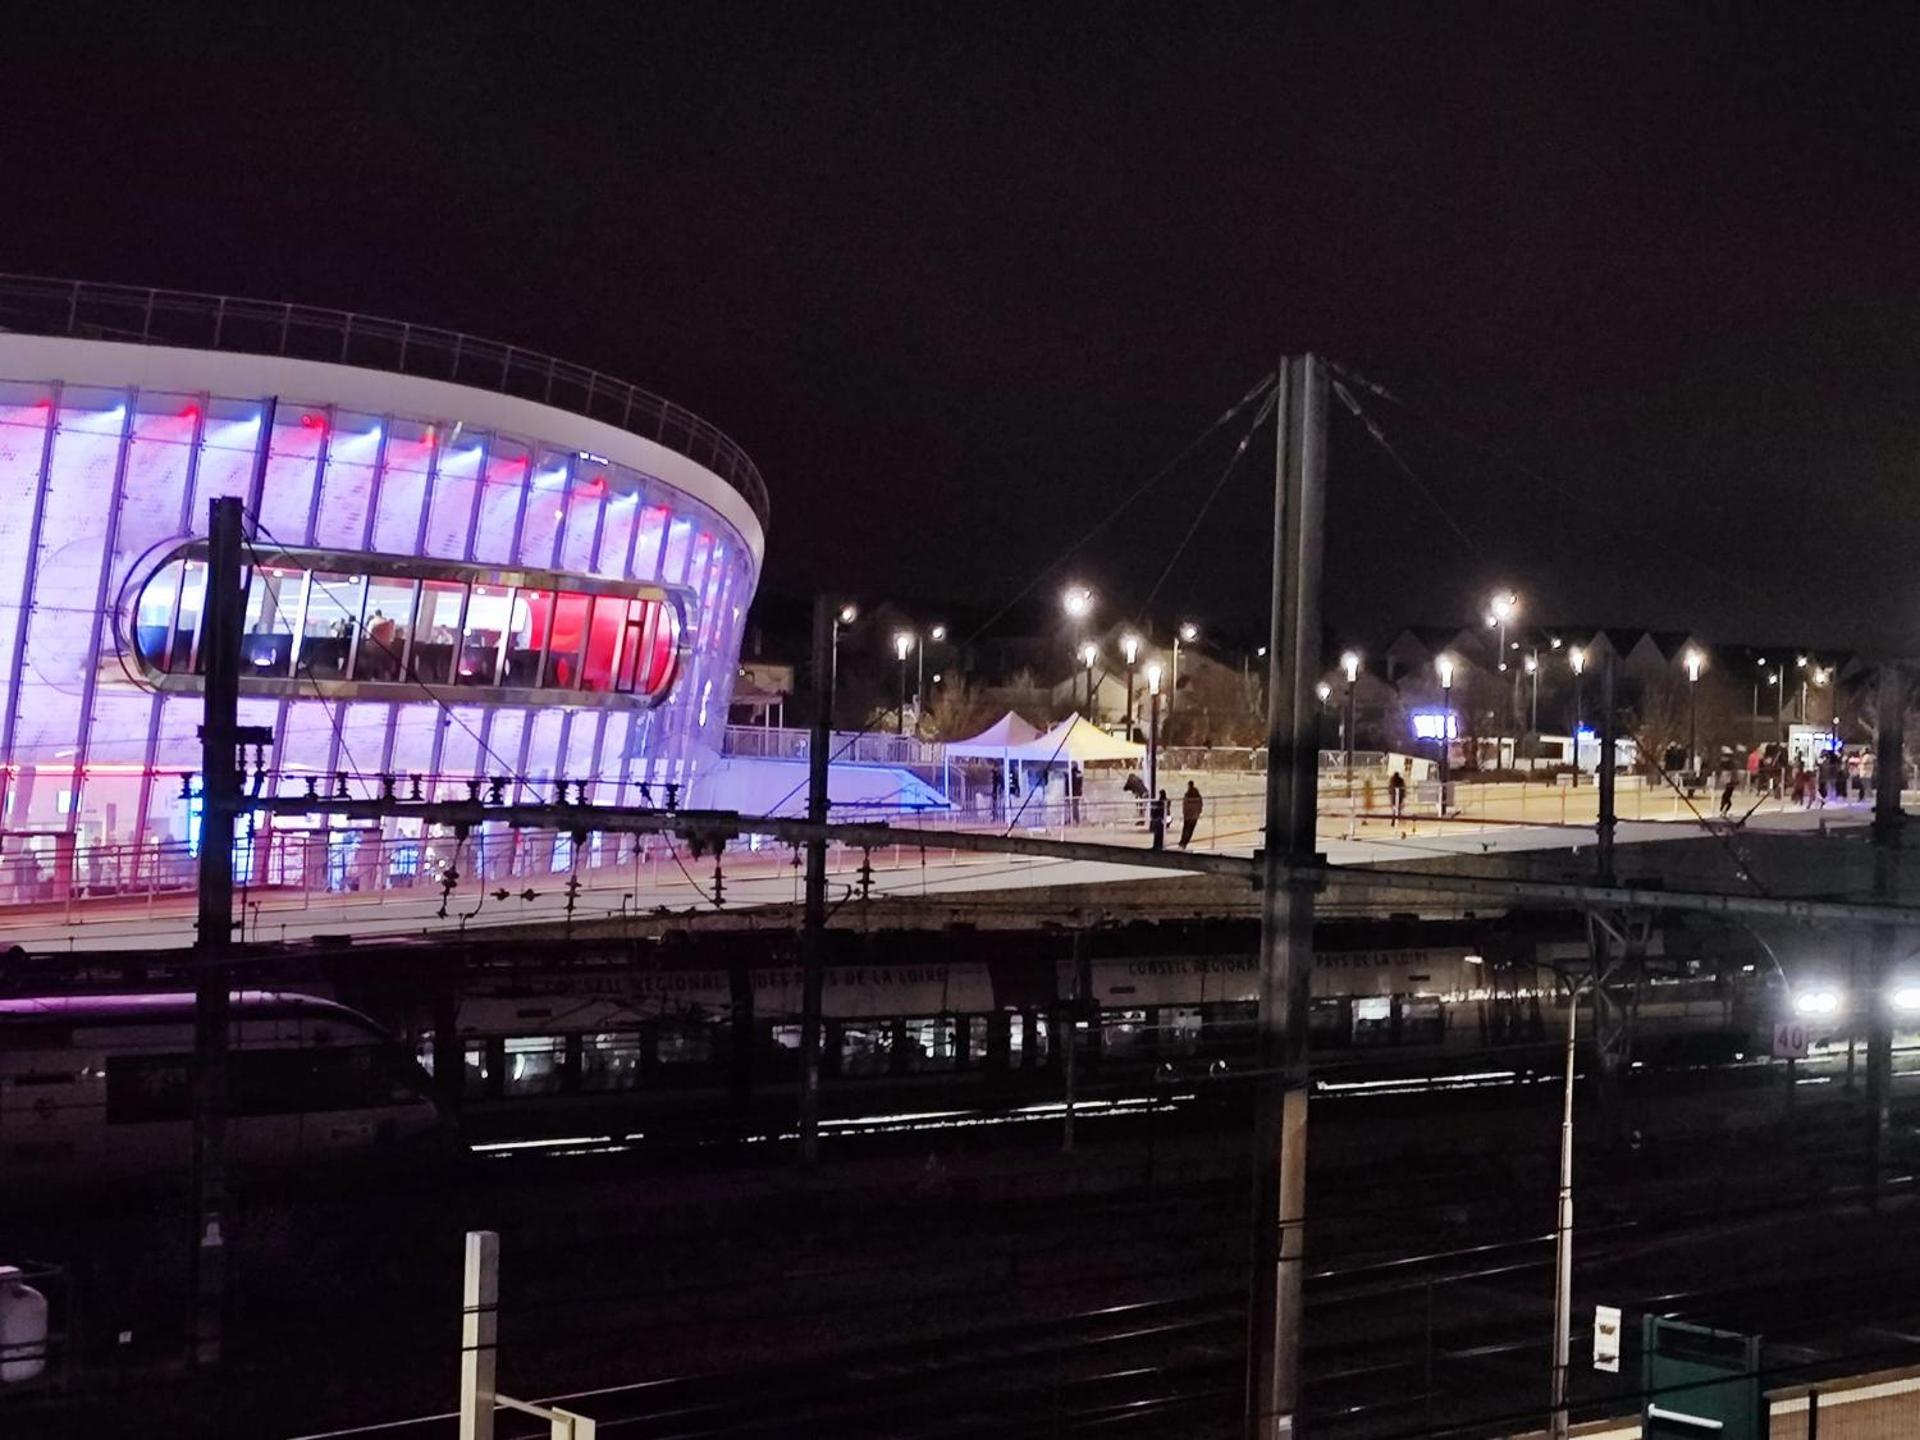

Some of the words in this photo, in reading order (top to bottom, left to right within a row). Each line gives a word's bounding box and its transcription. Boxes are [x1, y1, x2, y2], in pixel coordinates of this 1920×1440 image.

[1128, 959, 1188, 975] CONSEIL
[1316, 952, 1349, 968] PAYS
[1373, 951, 1390, 966] LA
[1777, 1026, 1803, 1050] 40
